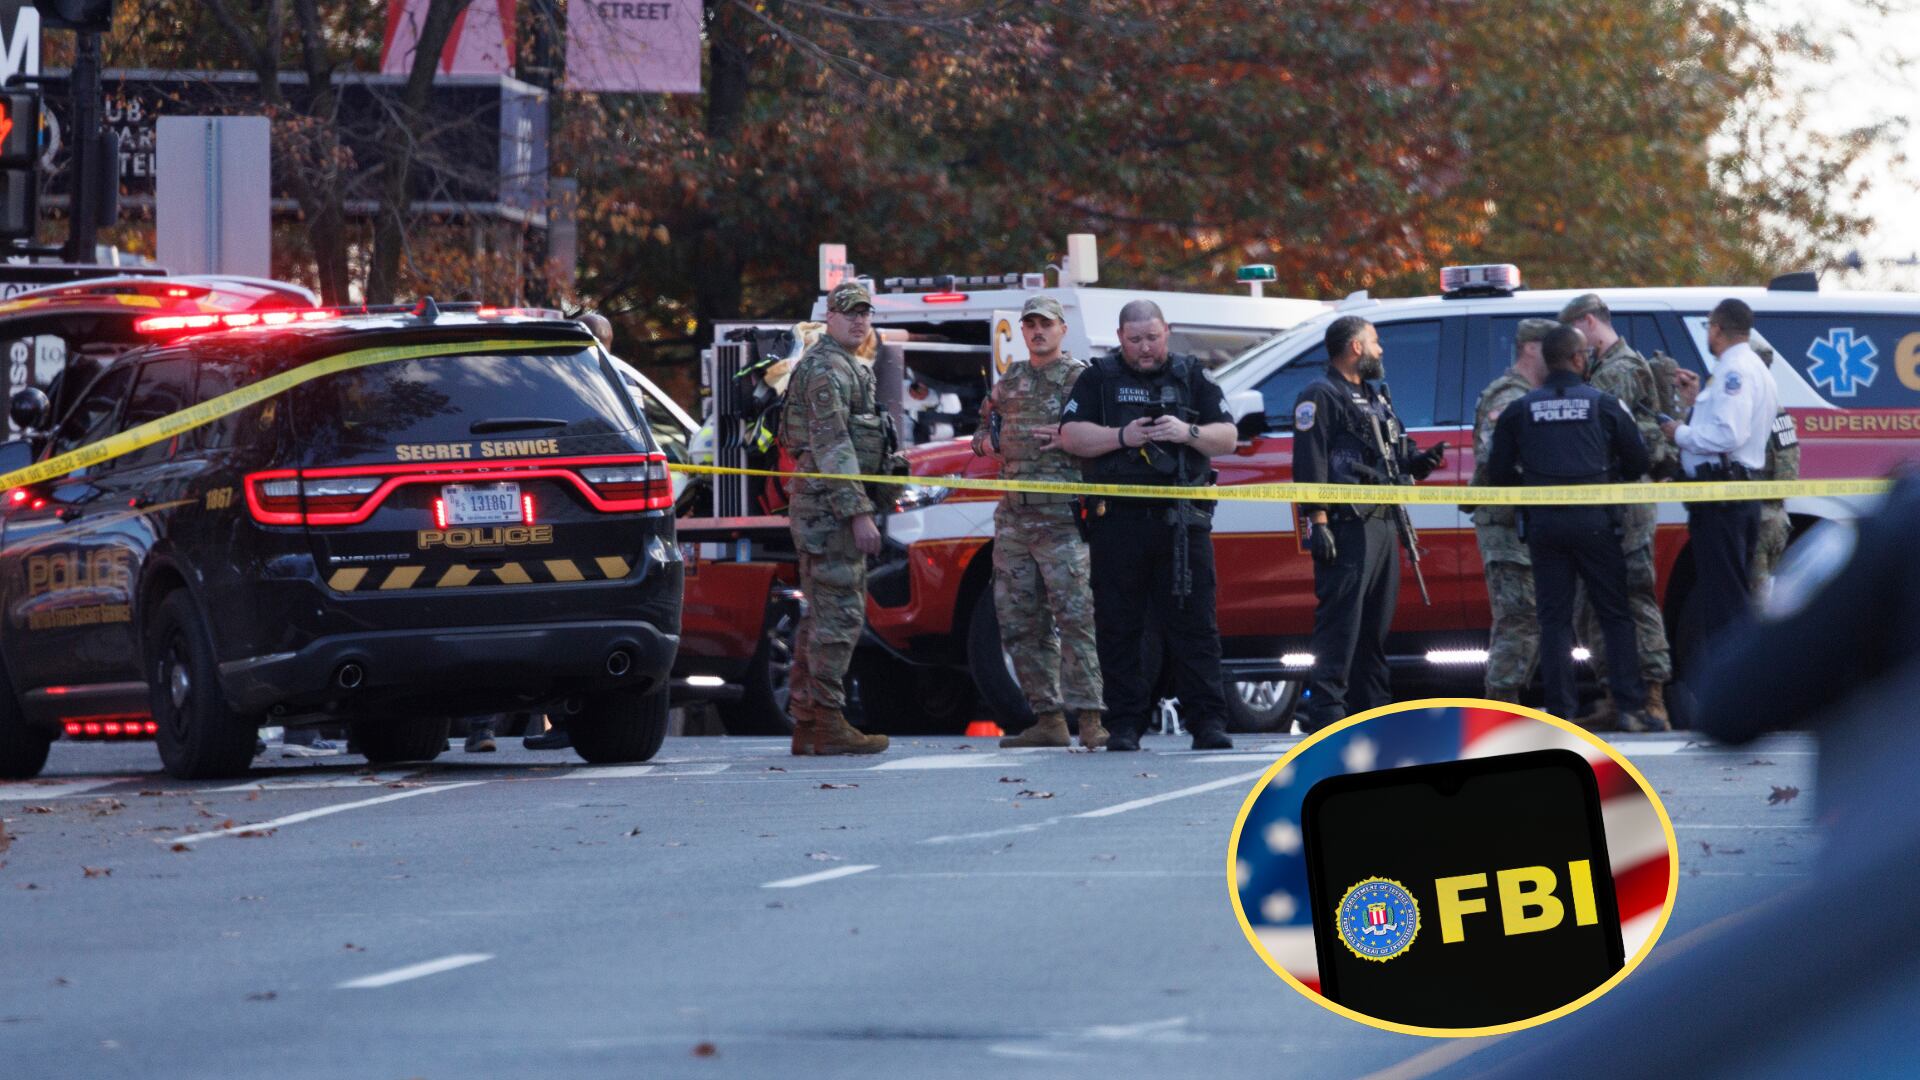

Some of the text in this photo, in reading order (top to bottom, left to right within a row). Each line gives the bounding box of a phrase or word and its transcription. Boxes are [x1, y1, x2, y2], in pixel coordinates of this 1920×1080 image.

[598, 1, 671, 20] STREET
[105, 97, 142, 121] UB
[118, 153, 157, 175] TEL
[1119, 387, 1150, 396] SECRET
[1533, 409, 1589, 422] POLICE
[395, 439, 560, 461] SECRET SERVICE
[206, 487, 233, 511] 1867
[471, 494, 514, 512] 131867
[417, 524, 553, 550] POLICE
[28, 550, 131, 595] POLICE
